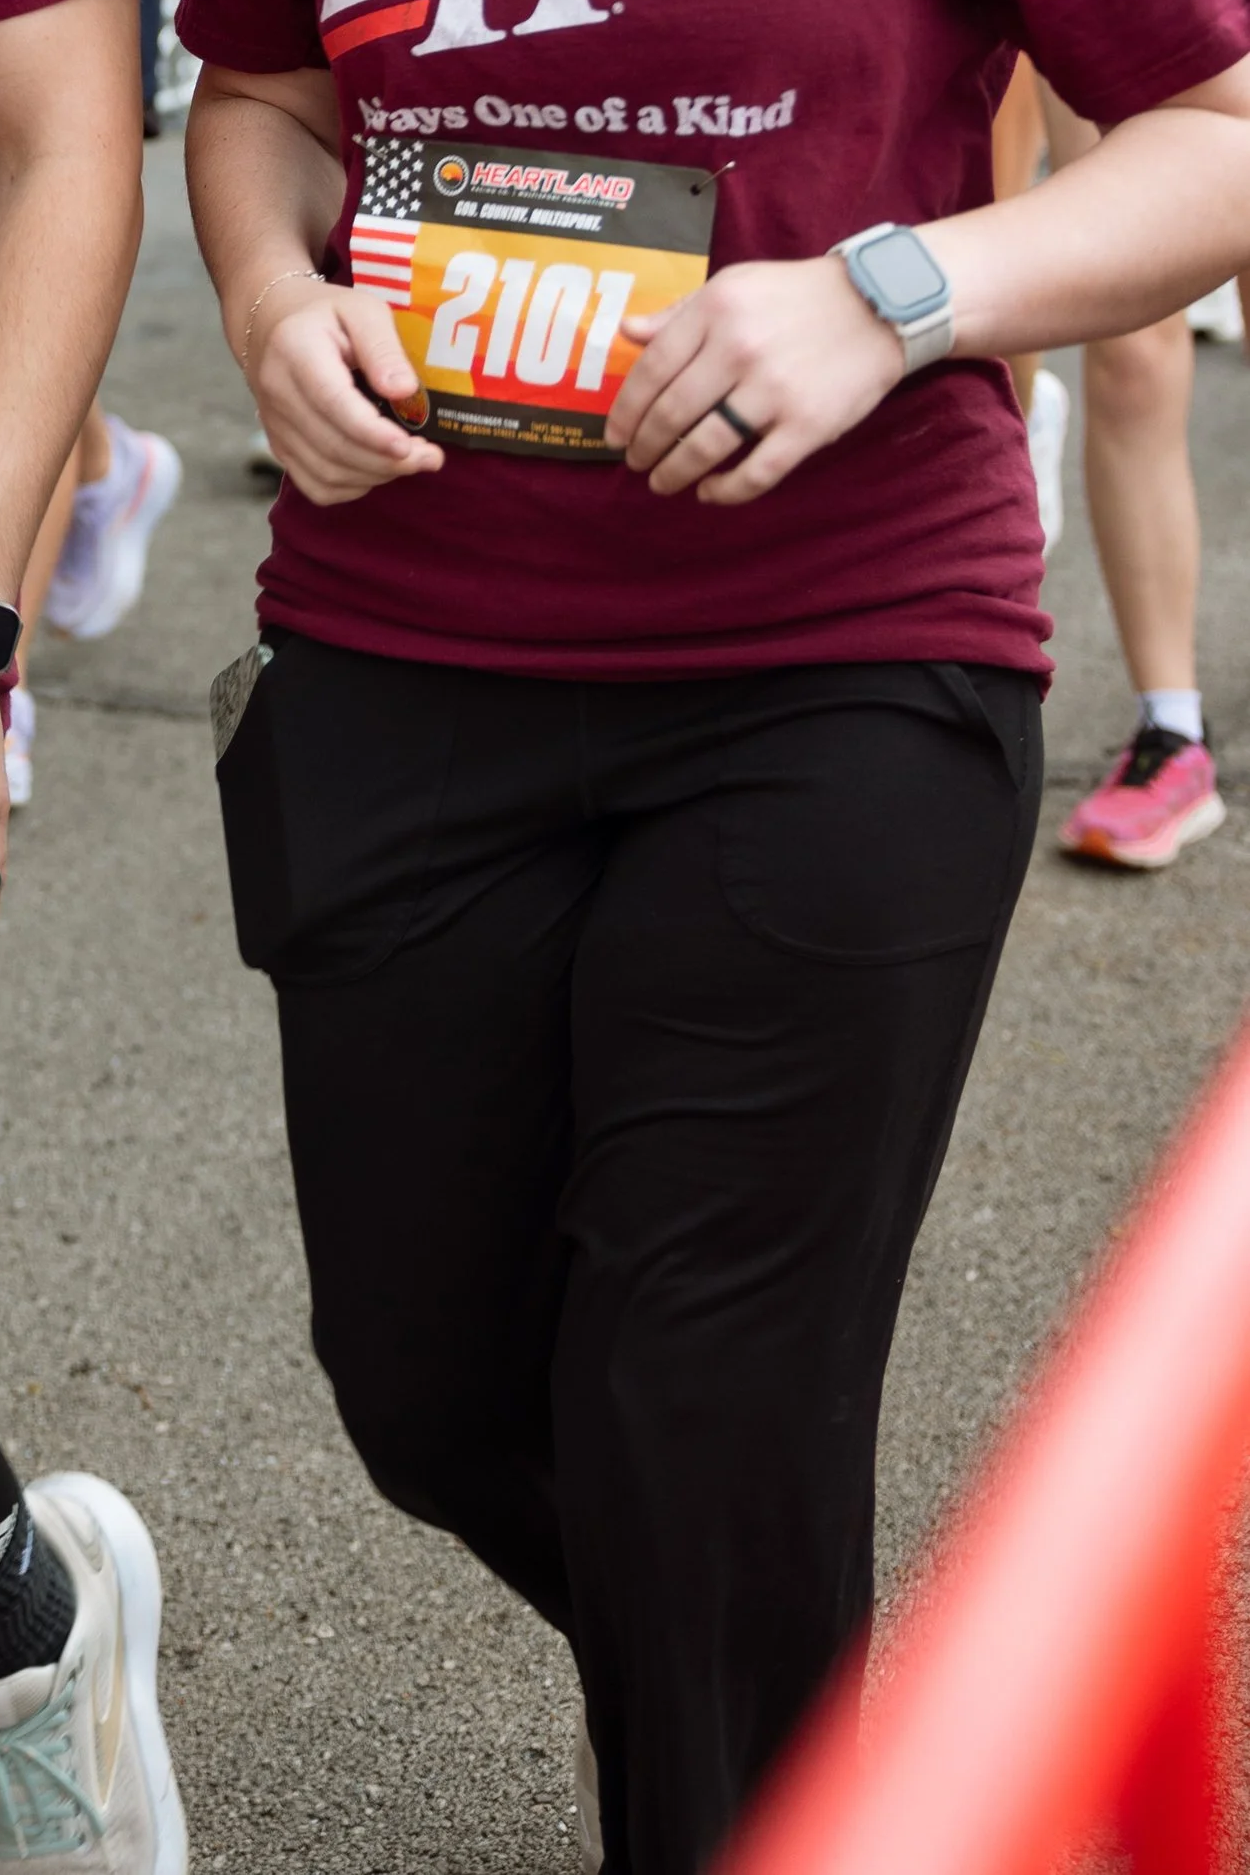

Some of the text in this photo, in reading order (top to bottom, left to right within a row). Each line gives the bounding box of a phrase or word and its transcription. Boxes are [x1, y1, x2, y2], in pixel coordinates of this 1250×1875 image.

[473, 95, 568, 130] One
[574, 96, 629, 134] of
[637, 107, 667, 135] a
[672, 88, 798, 138] Kind
[470, 161, 635, 203] HEARTLAND
[425, 251, 636, 393] 2101
